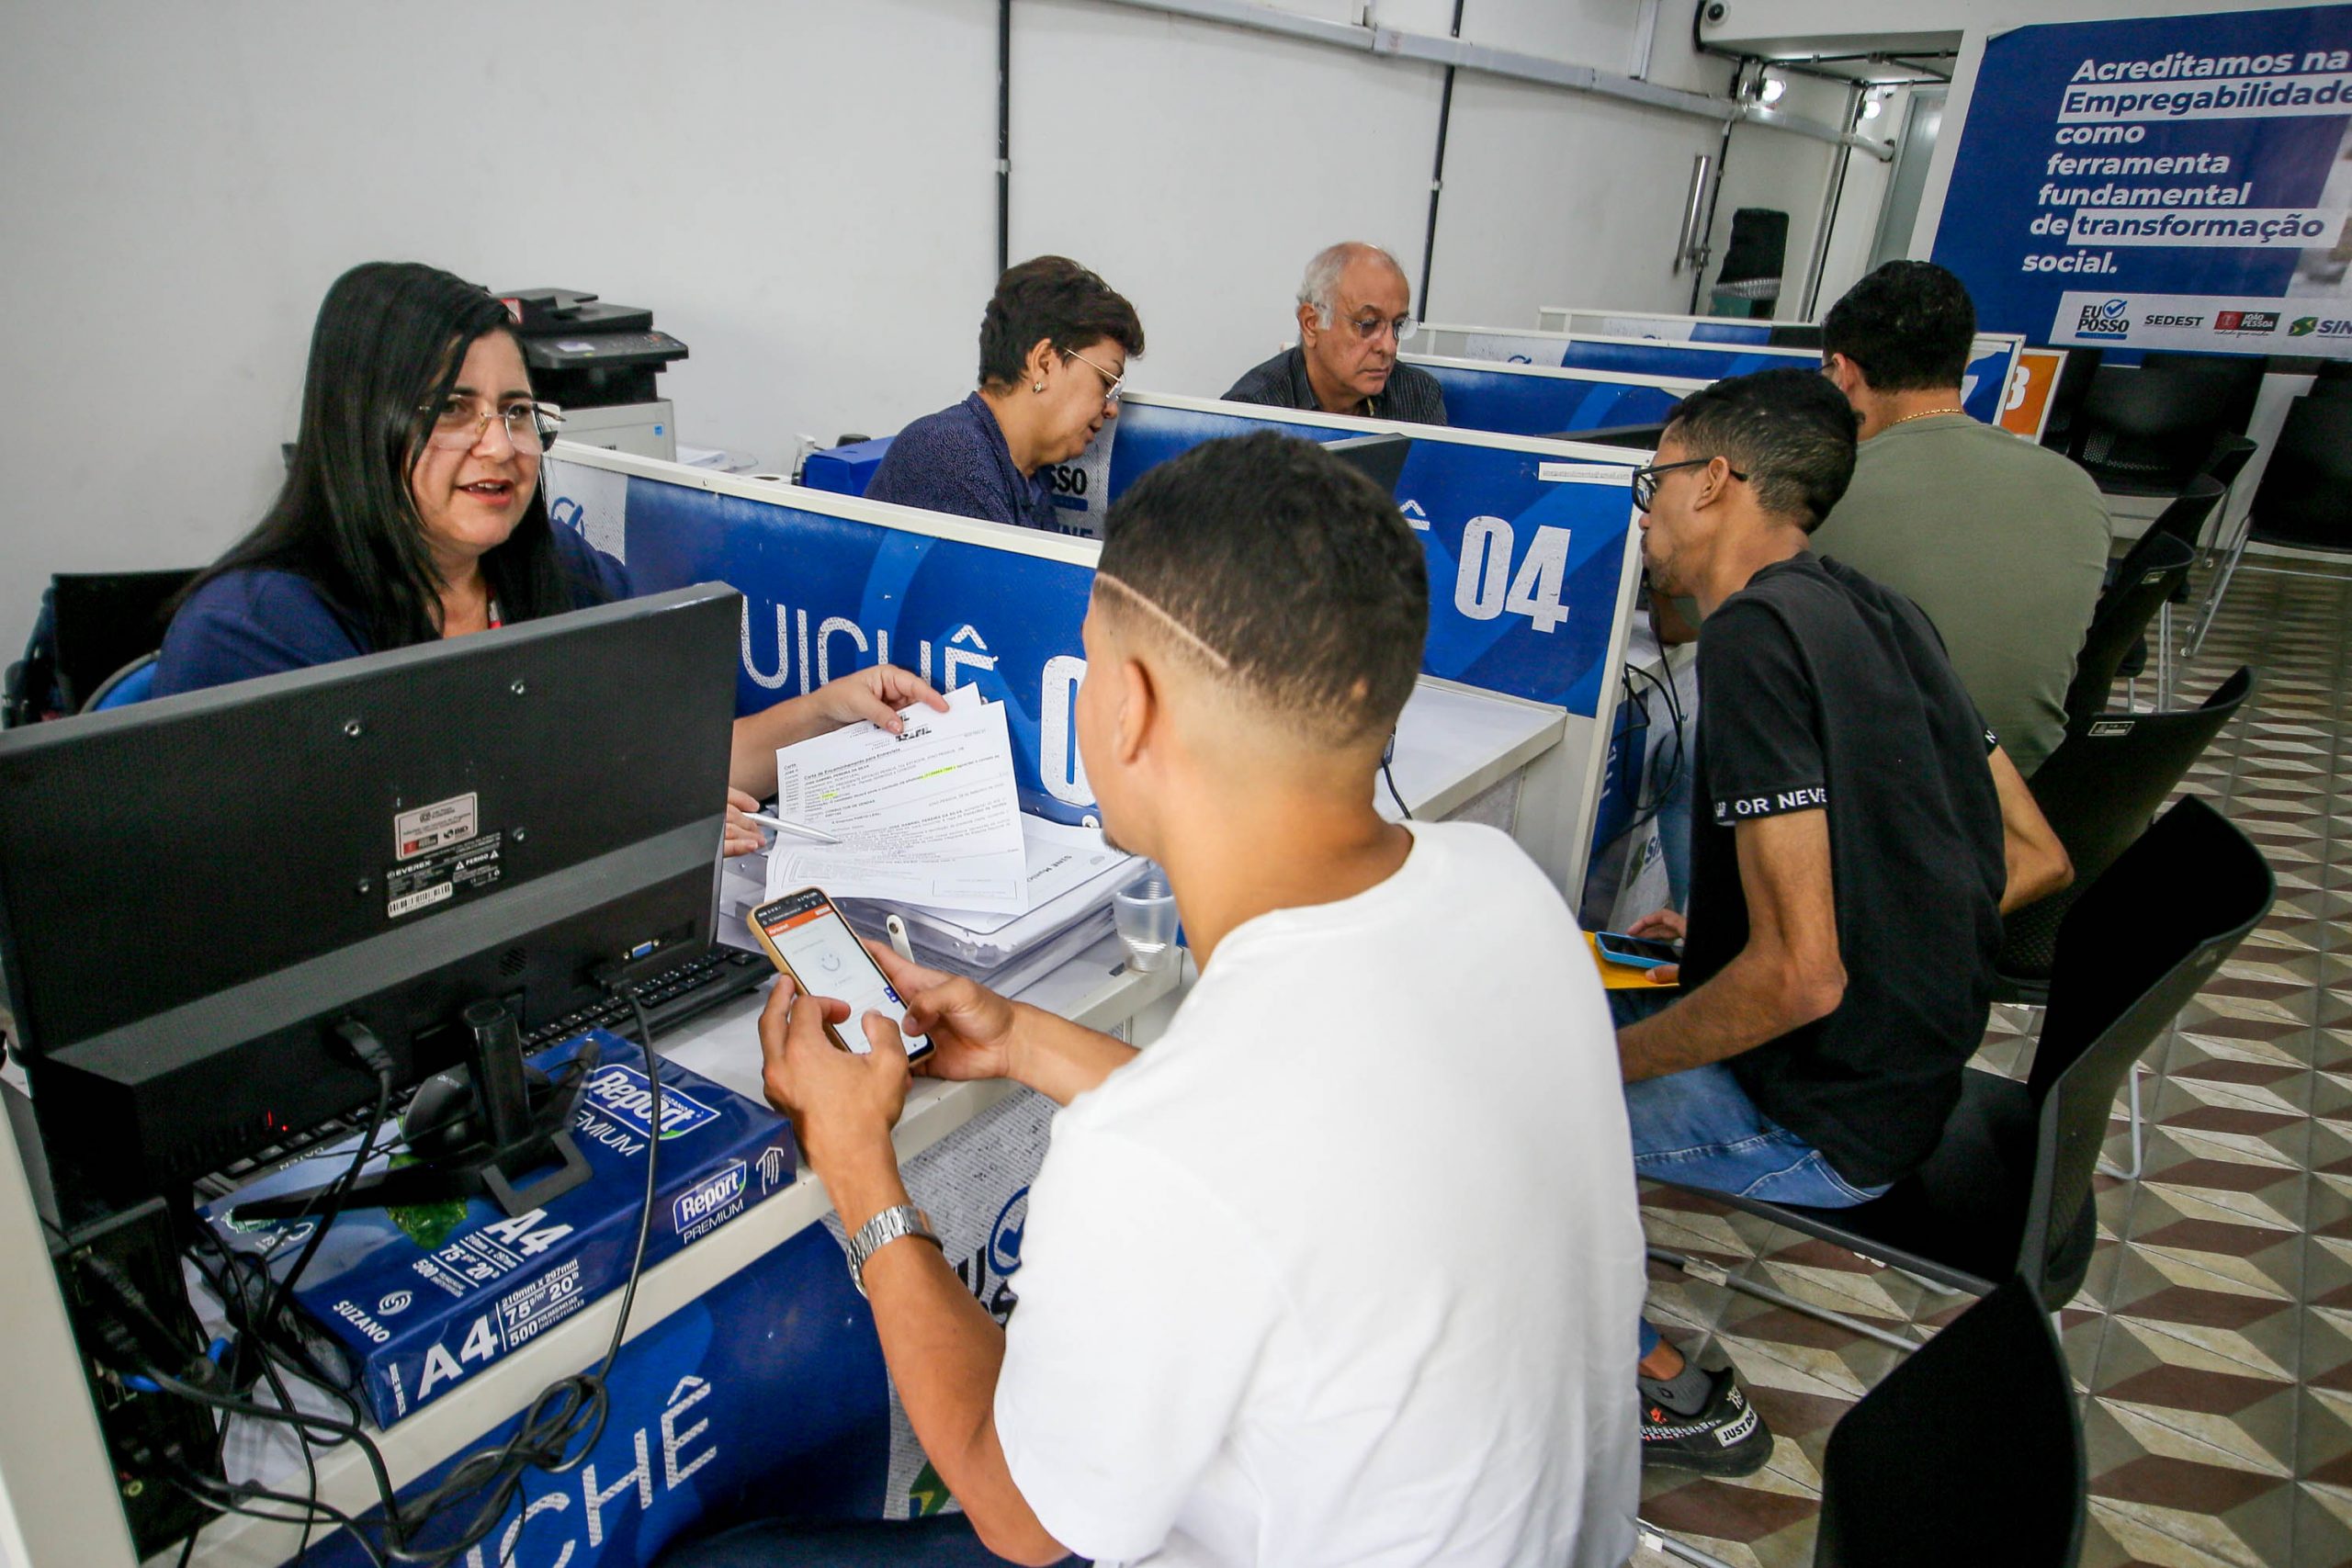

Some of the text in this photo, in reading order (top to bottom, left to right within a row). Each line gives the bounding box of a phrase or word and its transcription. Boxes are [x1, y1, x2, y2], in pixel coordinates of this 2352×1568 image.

[2071, 50, 2346, 83] Acreditamos na
[2055, 124, 2144, 144] como
[2047, 153, 2230, 175] ferramenta
[2039, 183, 2252, 206] fundamental
[2030, 213, 2324, 243] de transformação
[2022, 252, 2117, 275] social.
[2081, 305, 2102, 319] EU
[2144, 314, 2204, 327] SEDEST
[2077, 319, 2130, 333] POSSO
[2240, 320, 2274, 328] PESSOA
[1454, 514, 1571, 634] 04
[1736, 795, 1770, 816] OR
[576, 1110, 645, 1157] EMIUM
[682, 1170, 739, 1222] Report
[483, 1208, 573, 1257] A4
[684, 1198, 744, 1245] PREMIUM
[413, 1258, 439, 1279] 500
[333, 1300, 390, 1343] SUZANO
[509, 1319, 538, 1348] 500
[417, 1314, 498, 1401] A4
[1723, 1423, 1747, 1440] JUST
